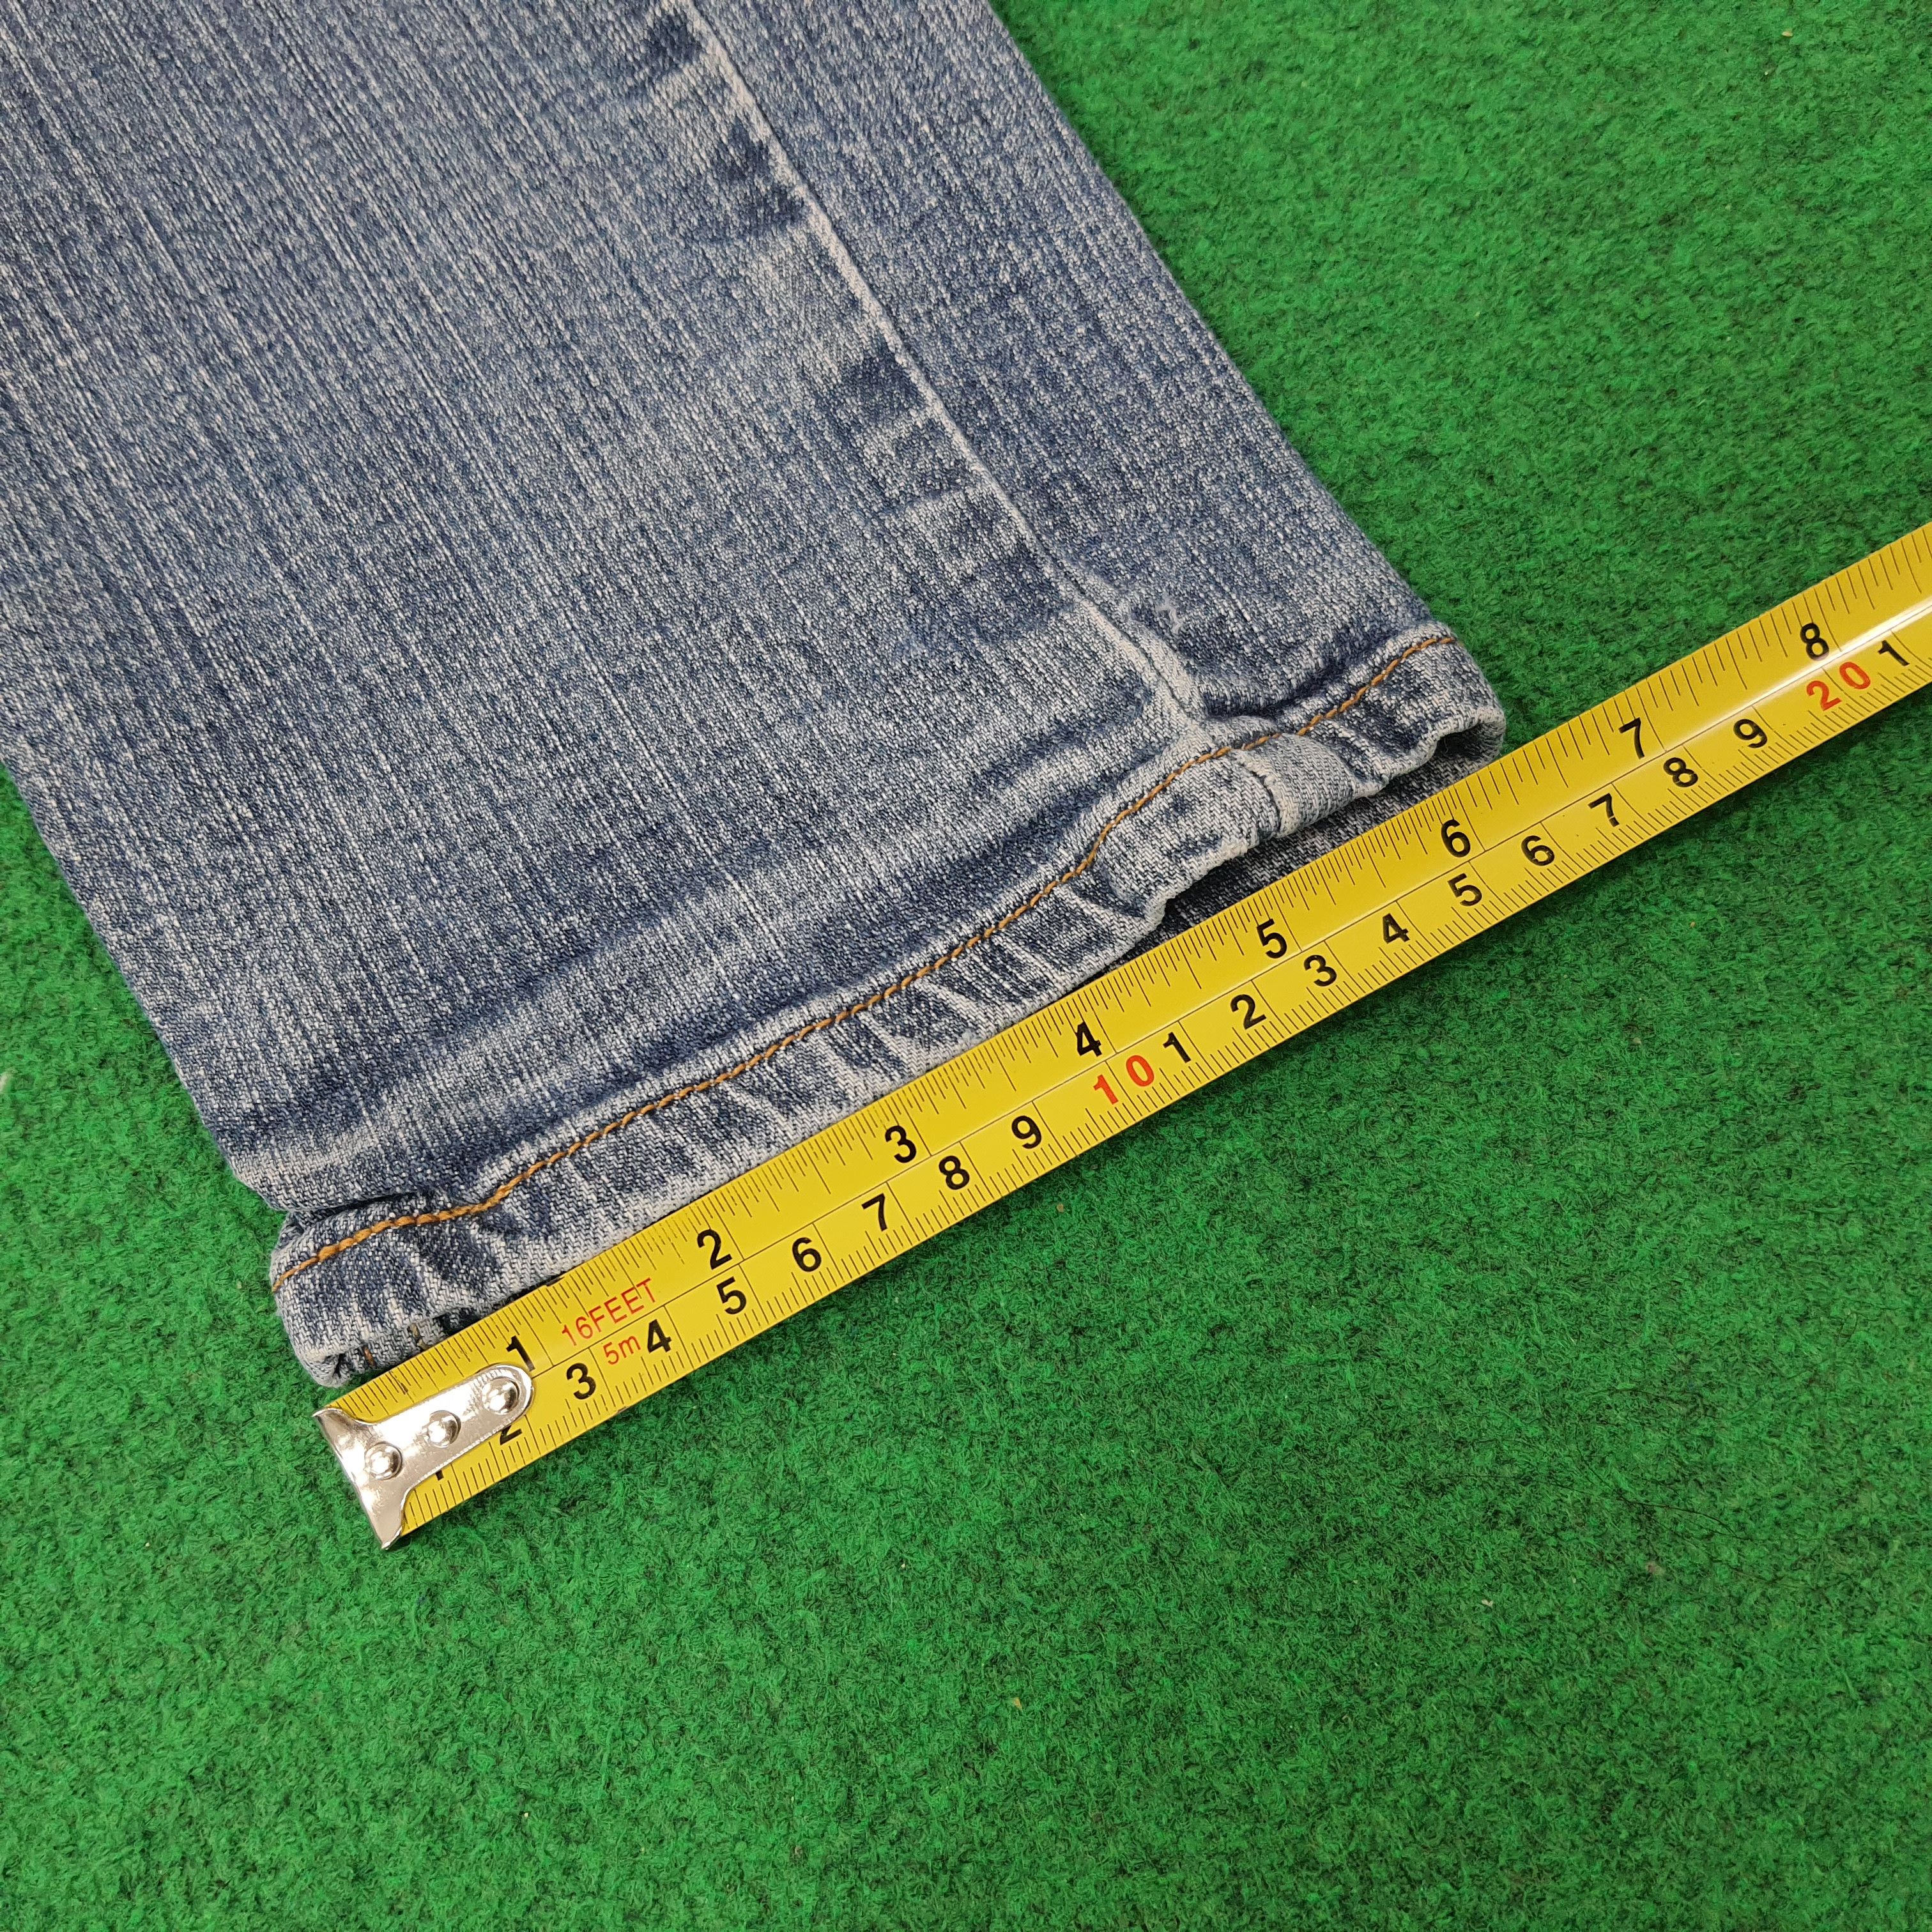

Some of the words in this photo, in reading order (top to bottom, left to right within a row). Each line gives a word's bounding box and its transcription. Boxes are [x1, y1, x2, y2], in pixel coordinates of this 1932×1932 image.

[506, 1335, 536, 1372] 1
[697, 1229, 732, 1269] 2
[884, 1125, 916, 1163] 3
[1076, 1022, 1101, 1057] 4
[1256, 918, 1287, 959] 5
[1441, 819, 1470, 858] 6
[1619, 717, 1647, 760] 7
[1799, 622, 1830, 661] 8
[566, 1363, 596, 1399] 3
[646, 1320, 671, 1354] 4
[717, 1277, 747, 1315] 5
[792, 1238, 821, 1272] 6
[861, 1193, 888, 1232] 7
[939, 1155, 970, 1190] 8
[1011, 1116, 1042, 1149] 9
[1162, 1031, 1191, 1063] 1
[1230, 993, 1267, 1030] 2
[1303, 954, 1337, 987] 3
[1381, 912, 1409, 944] 4
[1447, 873, 1482, 907] 5
[1521, 834, 1555, 867] 6
[1588, 793, 1620, 828] 7
[1663, 756, 1699, 788] 8
[1733, 718, 1768, 750] 9
[1878, 640, 1910, 668] 1
[562, 1278, 657, 1346] 16FEET
[603, 1333, 641, 1365] 5m
